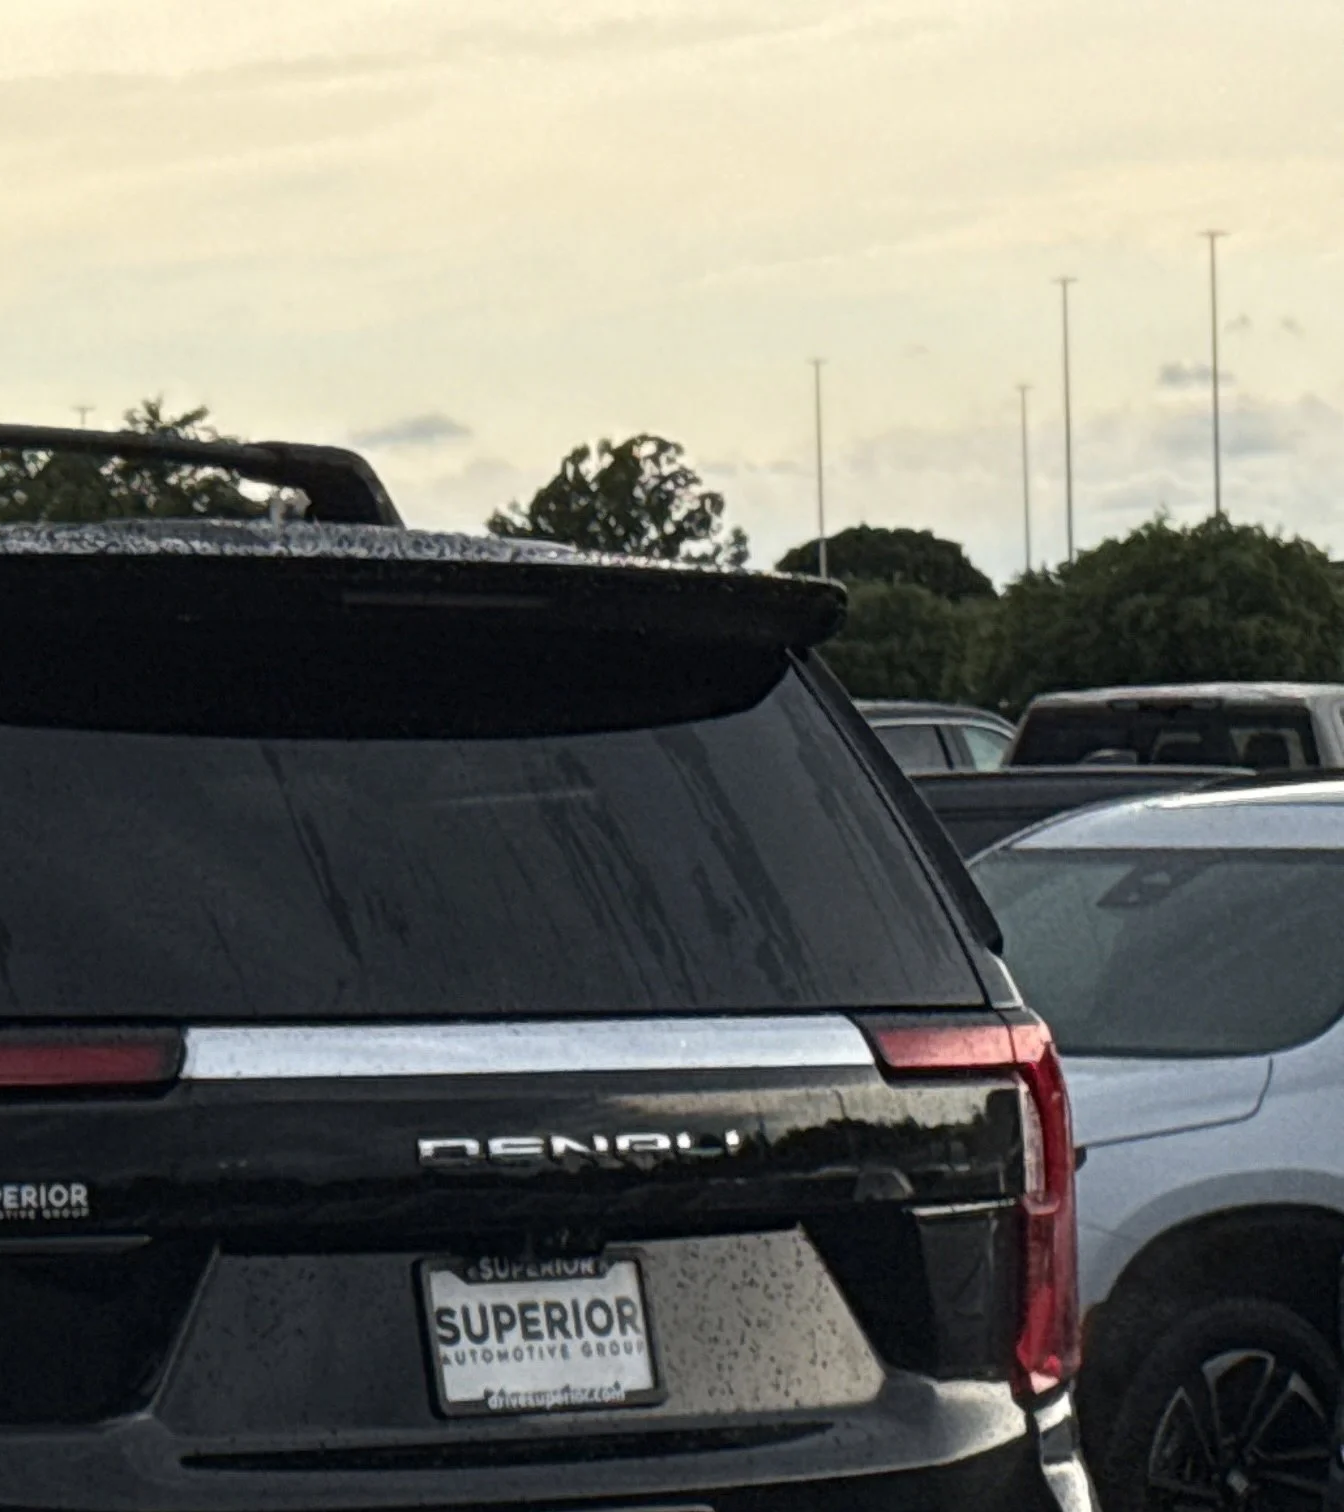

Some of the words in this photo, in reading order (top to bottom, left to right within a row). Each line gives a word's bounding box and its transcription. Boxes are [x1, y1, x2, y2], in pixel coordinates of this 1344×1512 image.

[417, 1129, 742, 1166] DENALI
[477, 1256, 597, 1281] SUPERIOR
[435, 1296, 641, 1346] SUPERIOR
[440, 1342, 570, 1366] AUTOMOTIVE
